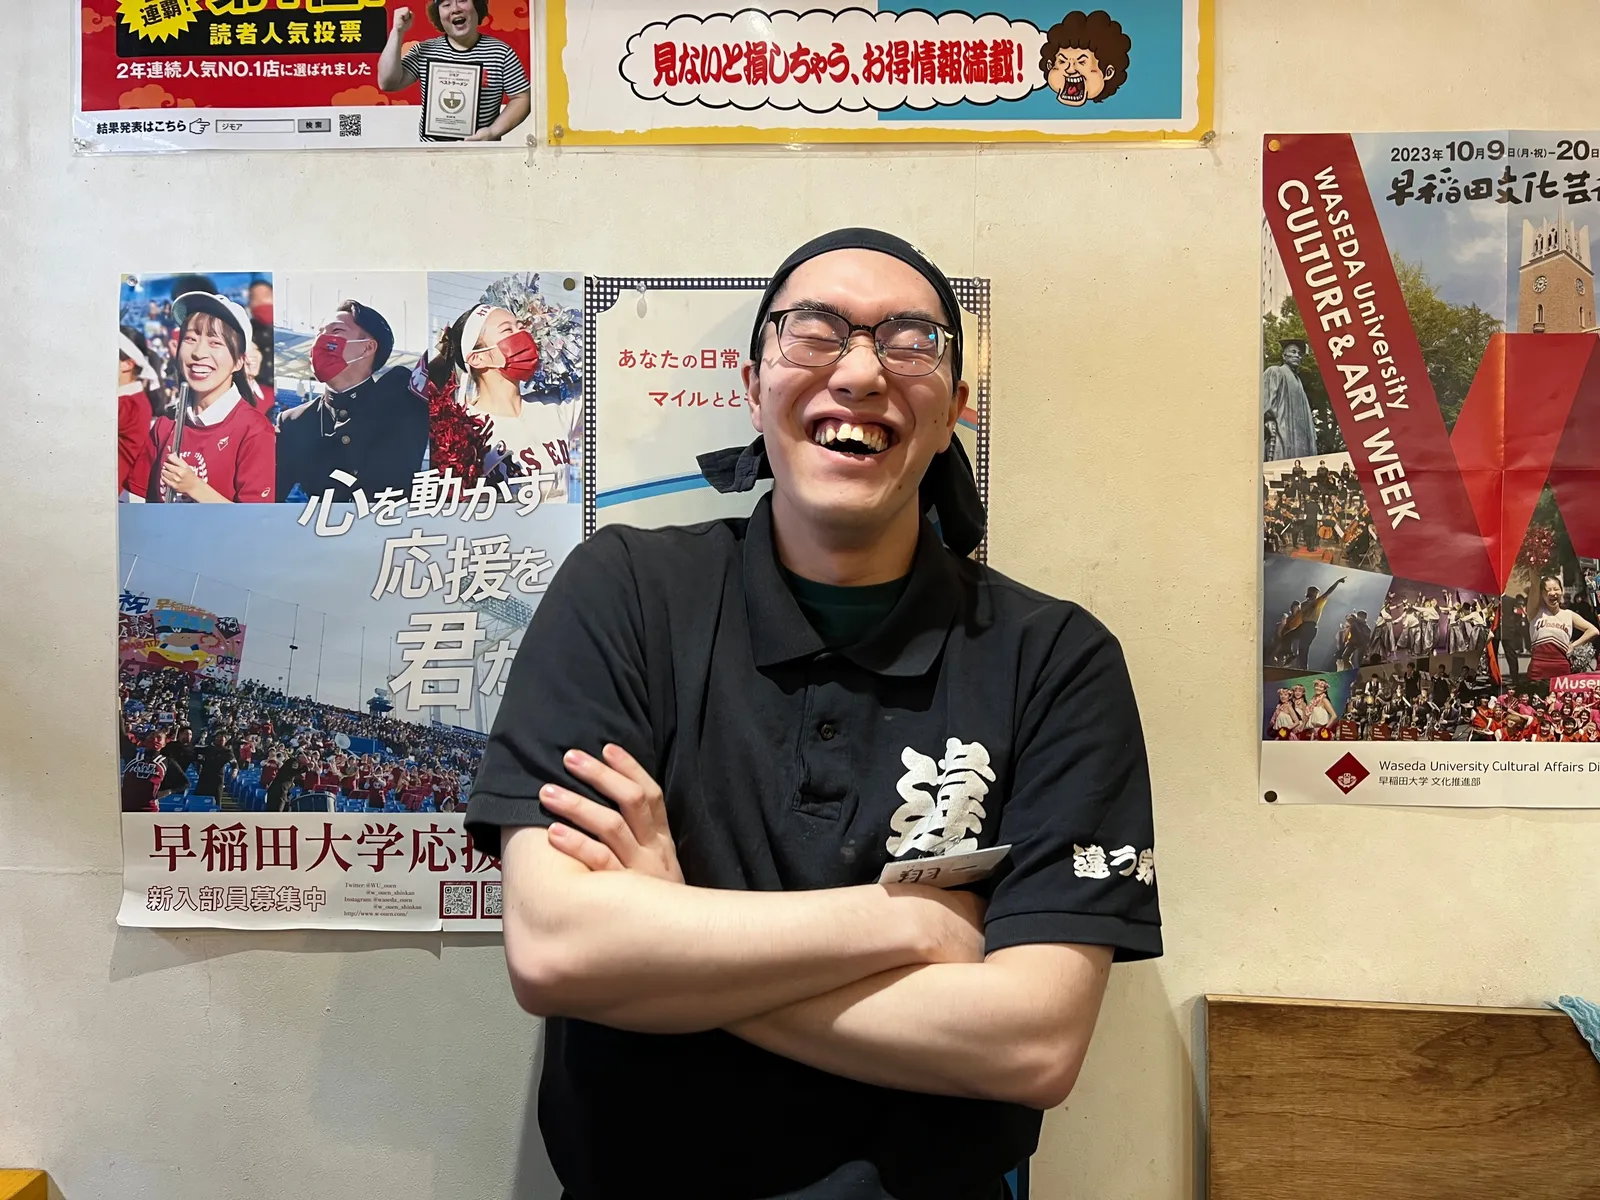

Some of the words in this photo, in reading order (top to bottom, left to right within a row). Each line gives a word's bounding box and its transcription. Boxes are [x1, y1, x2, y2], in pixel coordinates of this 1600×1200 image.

[209, 20, 362, 45] 読者人気投票
[116, 60, 372, 79] 2年連続人気NO.1店に選ばれました
[97, 120, 187, 134] 結果発表はこちら
[221, 122, 243, 131] ジモア
[305, 121, 323, 129] 検索
[1277, 179, 1353, 332] CULTURE
[1314, 165, 1366, 279] WASEDA
[1353, 281, 1410, 410] University
[618, 349, 740, 369] あなたの日常
[1327, 335, 1356, 361] &
[1336, 363, 1385, 422] ART
[1362, 427, 1421, 530] WEEK
[297, 468, 556, 537] 心を動かす
[371, 528, 554, 604] 応援を
[1379, 761, 1426, 773] Waseda
[1430, 761, 1489, 775] University
[1492, 761, 1539, 773] Cultural
[1544, 762, 1584, 773] Affairs
[1378, 777, 1428, 786] 早稲田大学
[1431, 777, 1481, 787] 文化推進部
[146, 886, 327, 912] 新入部員募集中
